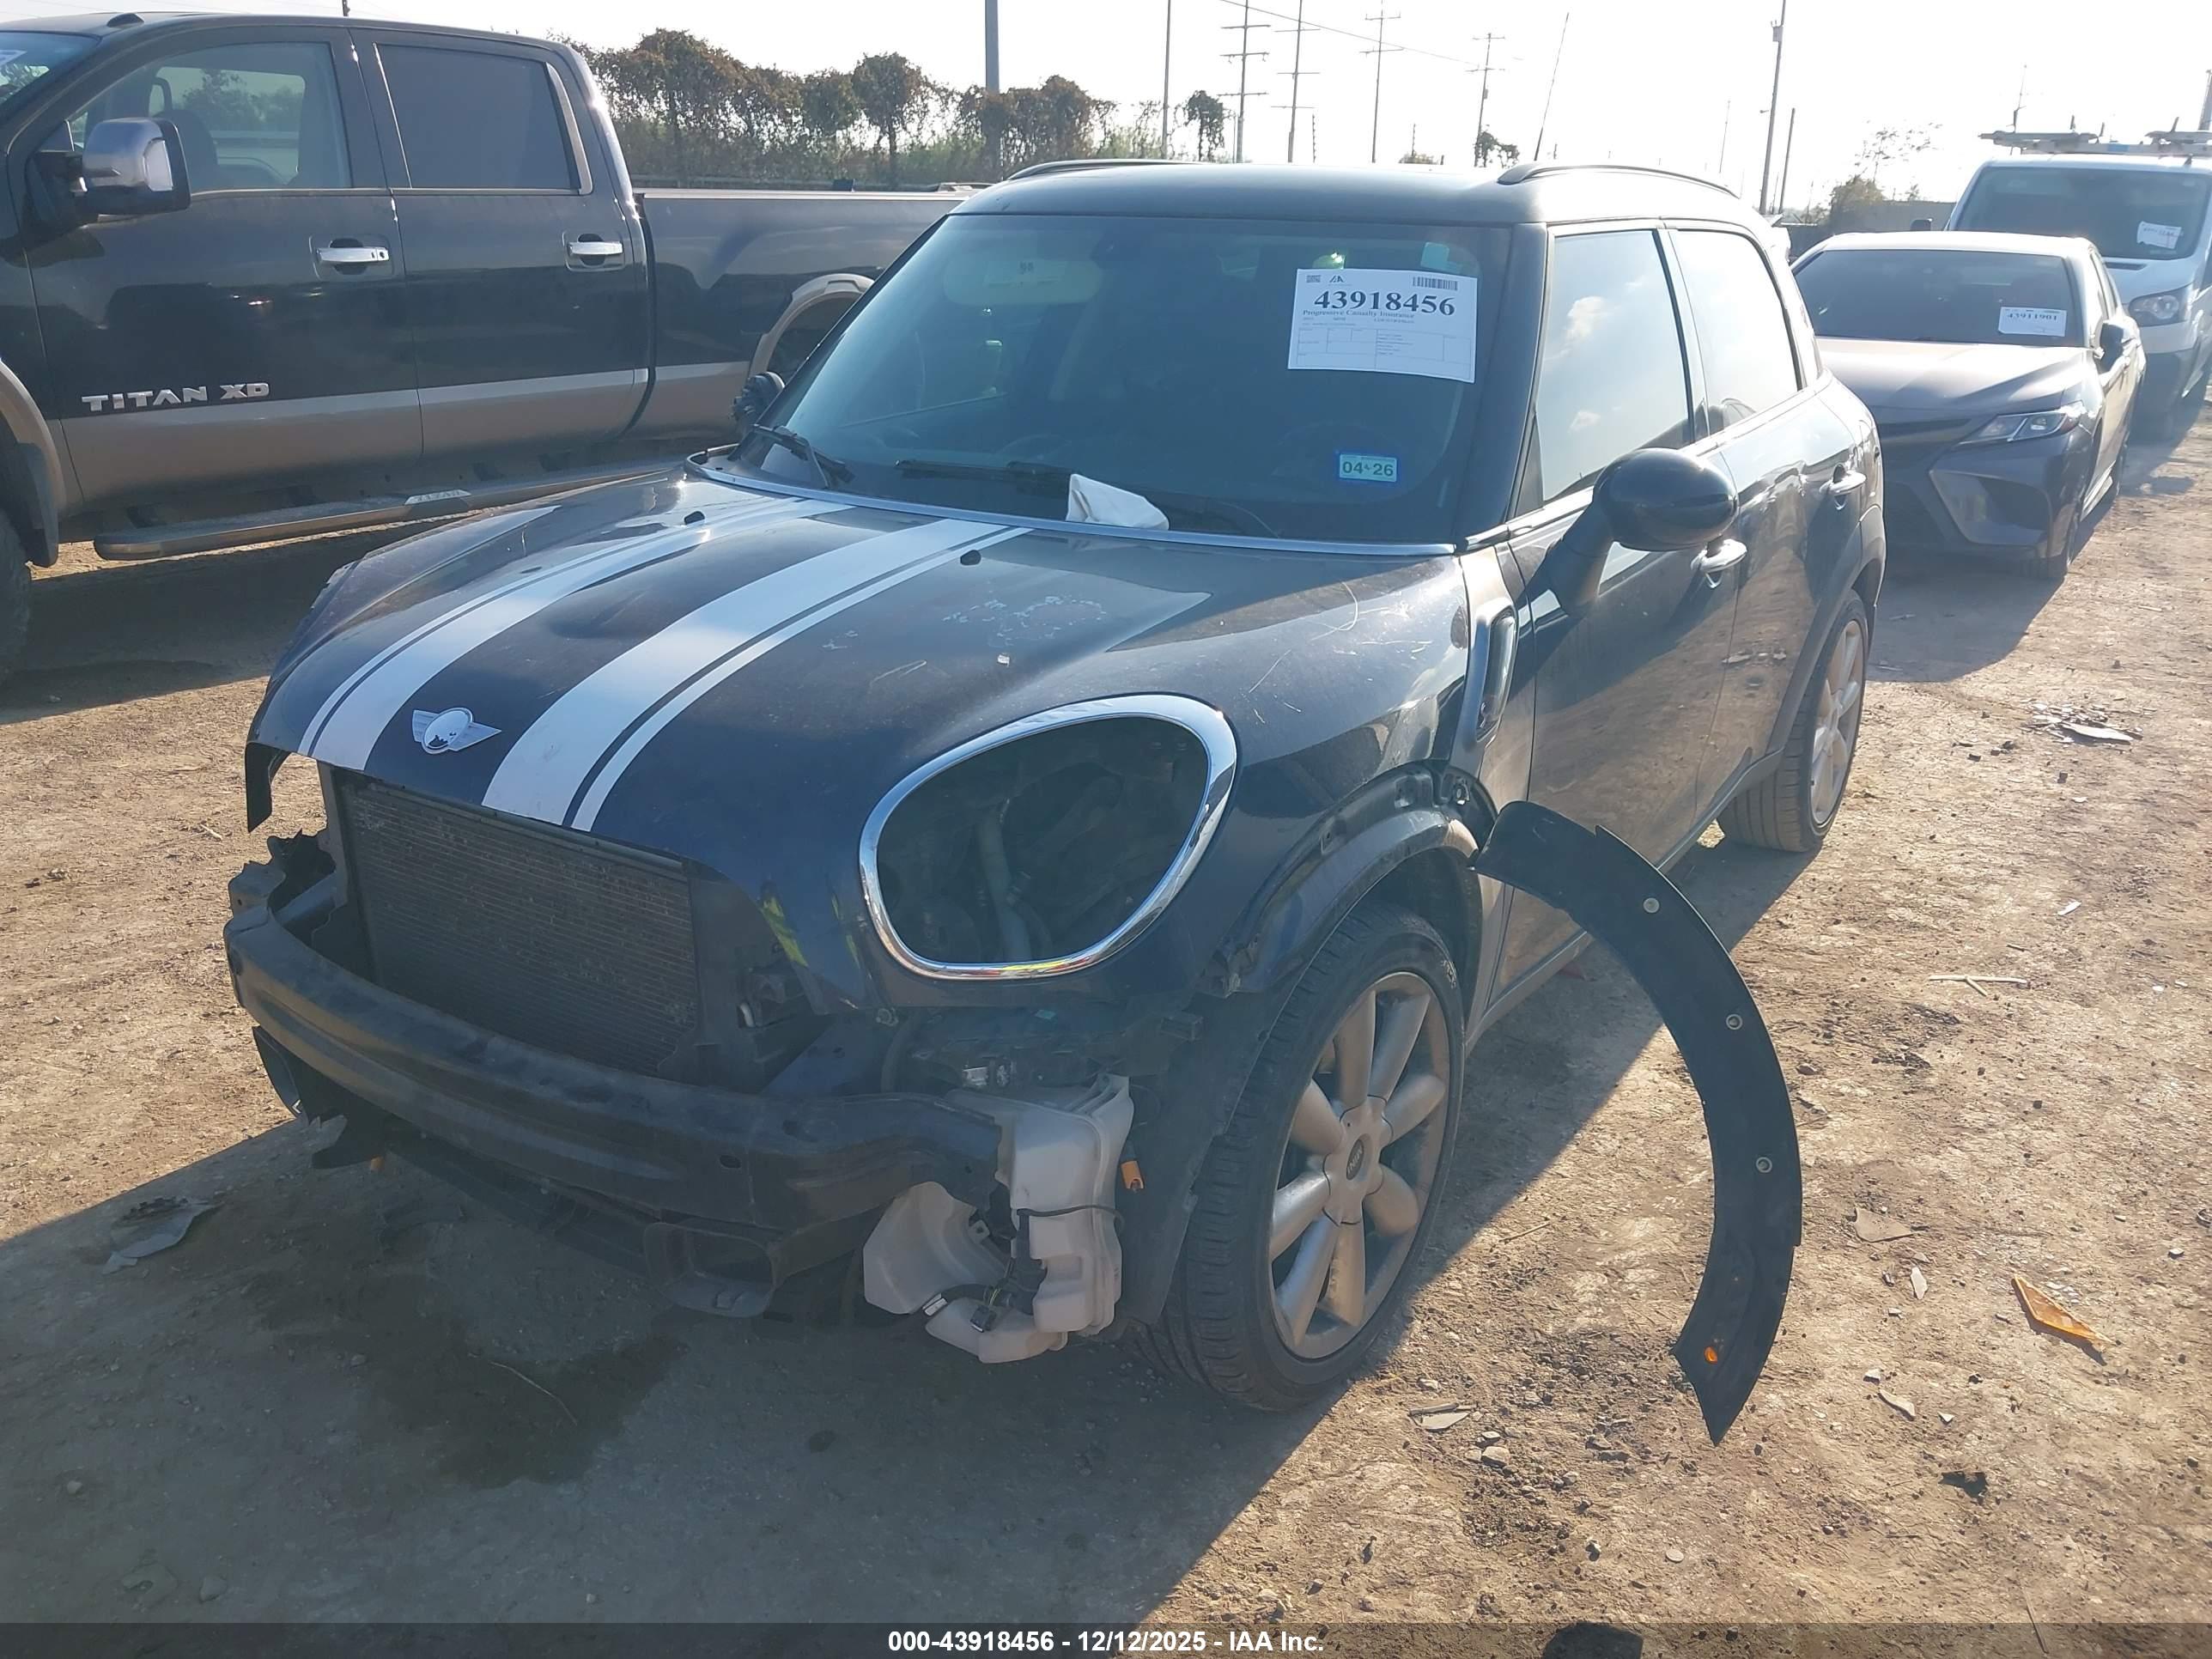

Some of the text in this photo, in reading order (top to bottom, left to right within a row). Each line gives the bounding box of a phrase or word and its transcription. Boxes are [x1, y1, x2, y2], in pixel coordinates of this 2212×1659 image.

[1314, 289, 1455, 316] 43918456
[82, 382, 270, 412] TITAN XD
[1343, 461, 1394, 477] 04 26
